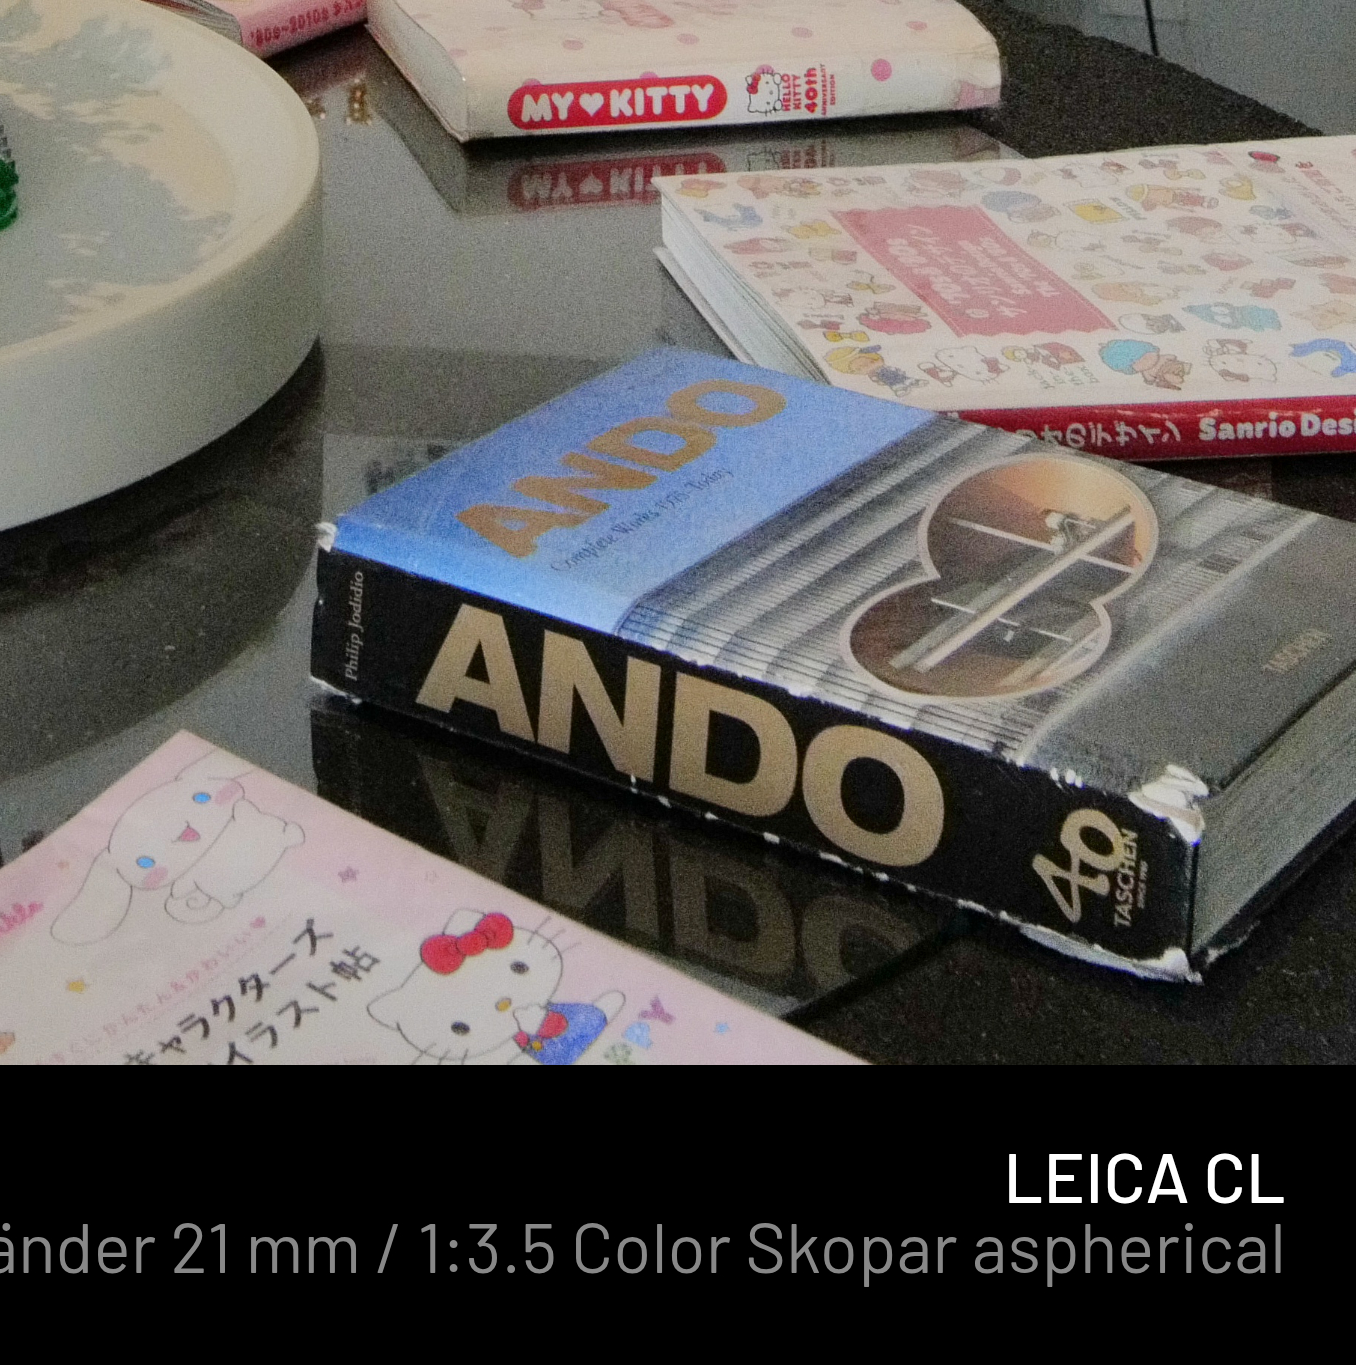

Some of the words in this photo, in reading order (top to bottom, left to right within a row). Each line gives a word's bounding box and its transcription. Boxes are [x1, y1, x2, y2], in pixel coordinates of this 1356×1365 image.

[519, 92, 574, 124] MY
[609, 83, 716, 117] KITTY
[780, 73, 791, 112] HELLO
[792, 74, 802, 111] KITTY
[803, 67, 818, 114] 40th
[1198, 411, 1295, 443] Sanrio
[456, 378, 786, 561] ANDO
[346, 570, 365, 633] Jodidio
[344, 632, 364, 682] Philip
[416, 604, 946, 869] ANDO
[1032, 808, 1125, 923] 40
[1113, 827, 1139, 927] TASCHEN
